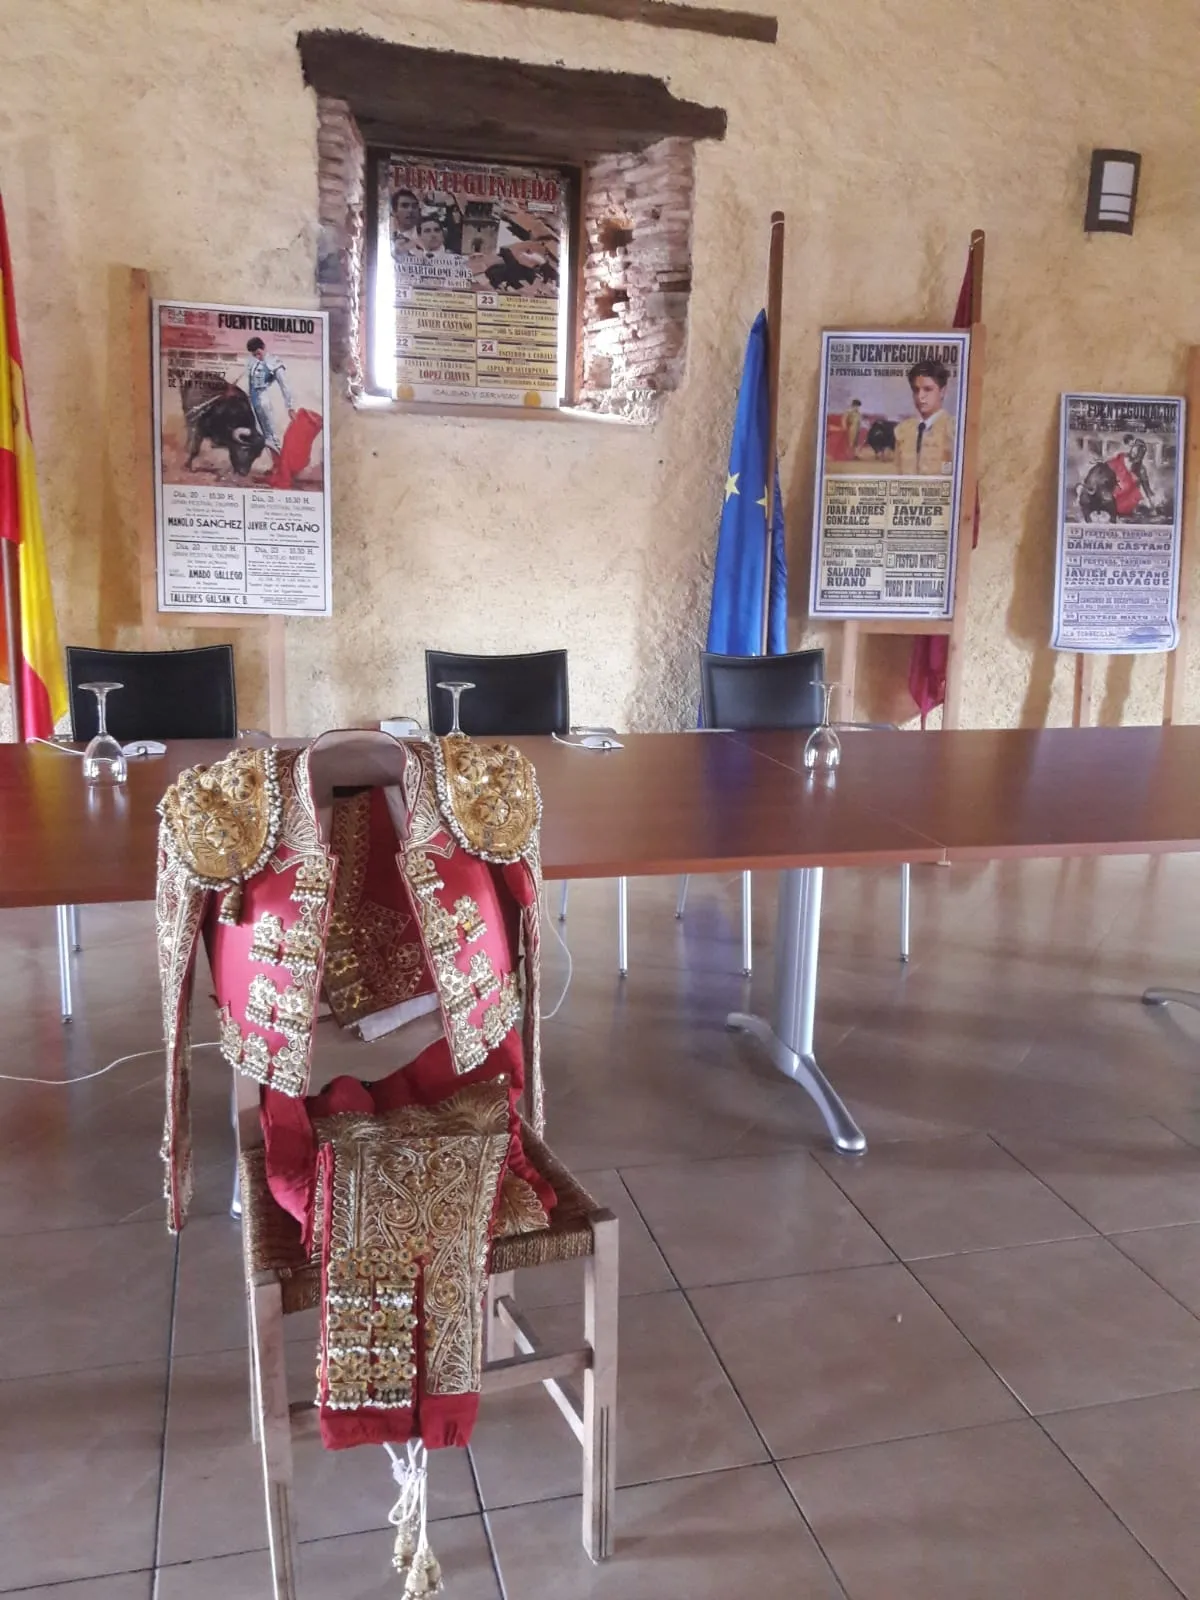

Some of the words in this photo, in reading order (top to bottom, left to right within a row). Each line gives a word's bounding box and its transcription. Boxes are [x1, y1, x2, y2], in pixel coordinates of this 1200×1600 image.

[393, 166, 557, 201] FUENTEGUINALDO
[396, 290, 407, 298] 21
[481, 296, 494, 304] 23
[218, 313, 314, 335] FUENTEGUINALDO
[417, 318, 441, 329] JAVIER
[396, 338, 408, 346] 22
[481, 344, 494, 352] 24
[852, 344, 958, 364] FUENTEGUINALDO
[168, 378, 177, 388] DE
[826, 506, 848, 516] JUAN
[850, 506, 886, 516] ANDRES
[893, 506, 944, 517] JAVIER
[168, 516, 194, 528] MANOLO
[196, 518, 242, 530] SANCHEZ
[826, 516, 870, 526] GONZALEZ
[248, 521, 268, 531] JAVIER
[270, 522, 320, 533] CASTAÑO
[1067, 540, 1112, 550] DAMIAN
[188, 570, 211, 578] AMADO
[214, 570, 243, 580] GALLEGO
[827, 567, 872, 578] SALVADOR
[1066, 568, 1108, 578] JAVIER
[826, 577, 866, 588] RUANO
[1108, 577, 1170, 586] DOYAGUE
[914, 580, 945, 599] VAQUILLAS
[170, 592, 203, 603] TALLERES
[206, 594, 231, 604] GALSAN
